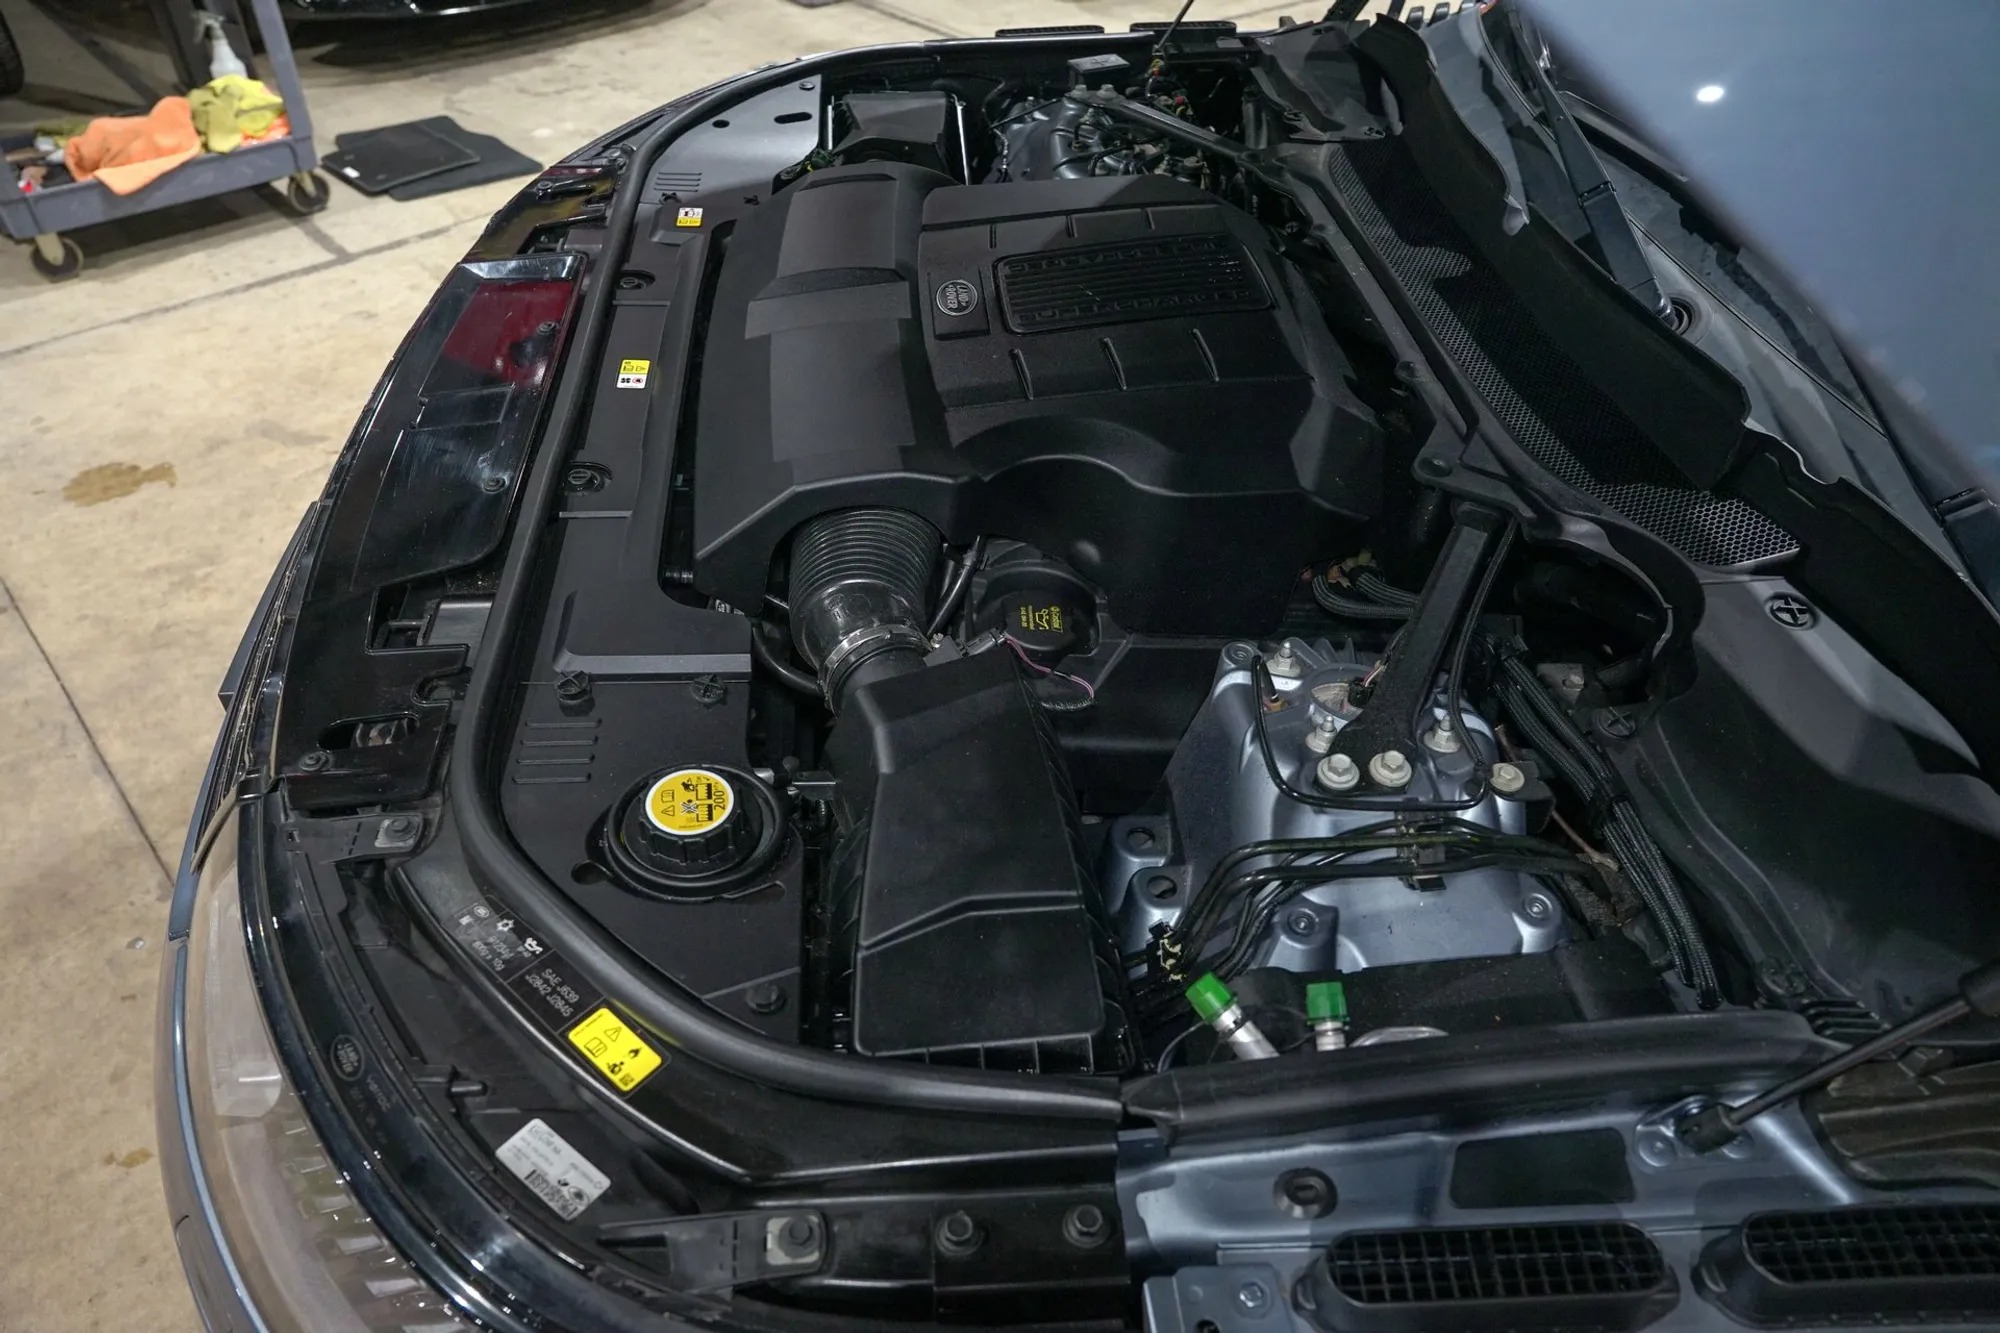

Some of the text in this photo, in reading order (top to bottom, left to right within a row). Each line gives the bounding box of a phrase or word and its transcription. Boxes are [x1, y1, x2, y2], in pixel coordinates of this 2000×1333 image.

[946, 287, 958, 309] ROVER
[956, 285, 968, 304] LAND
[713, 790, 726, 811] 200
[525, 973, 574, 1017] J2842 J2845
[542, 968, 580, 1004] SAE J639
